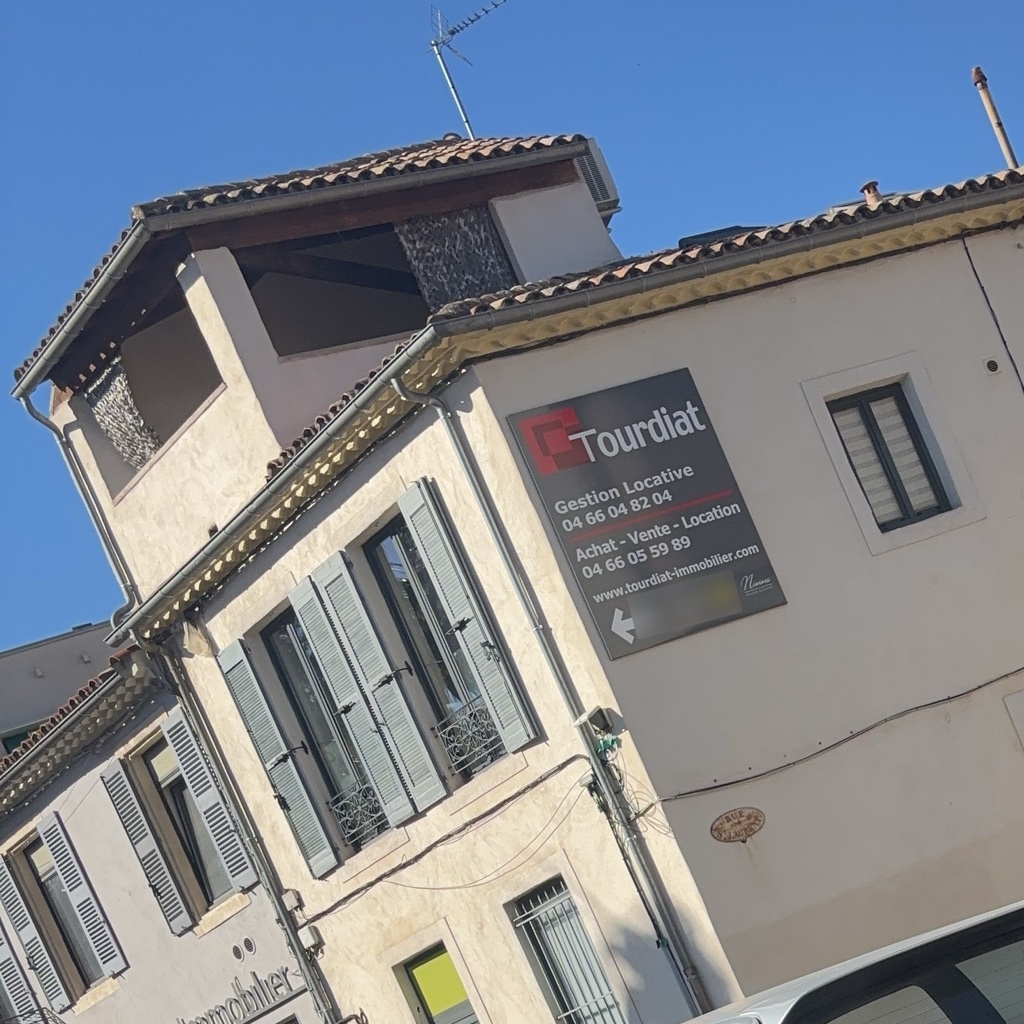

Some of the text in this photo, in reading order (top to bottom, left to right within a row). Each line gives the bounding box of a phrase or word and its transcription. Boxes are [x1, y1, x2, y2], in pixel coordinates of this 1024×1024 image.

[568, 400, 706, 463] Tourdiat
[554, 465, 695, 515] Gestion Locative
[562, 489, 673, 532] 04 66 04 82 04
[575, 538, 618, 562] Achat
[627, 523, 672, 545] Vente
[681, 502, 741, 529] Location
[582, 535, 691, 579] 04 66 05 59 89
[592, 543, 760, 603] www.tourdiat-immobilier.com
